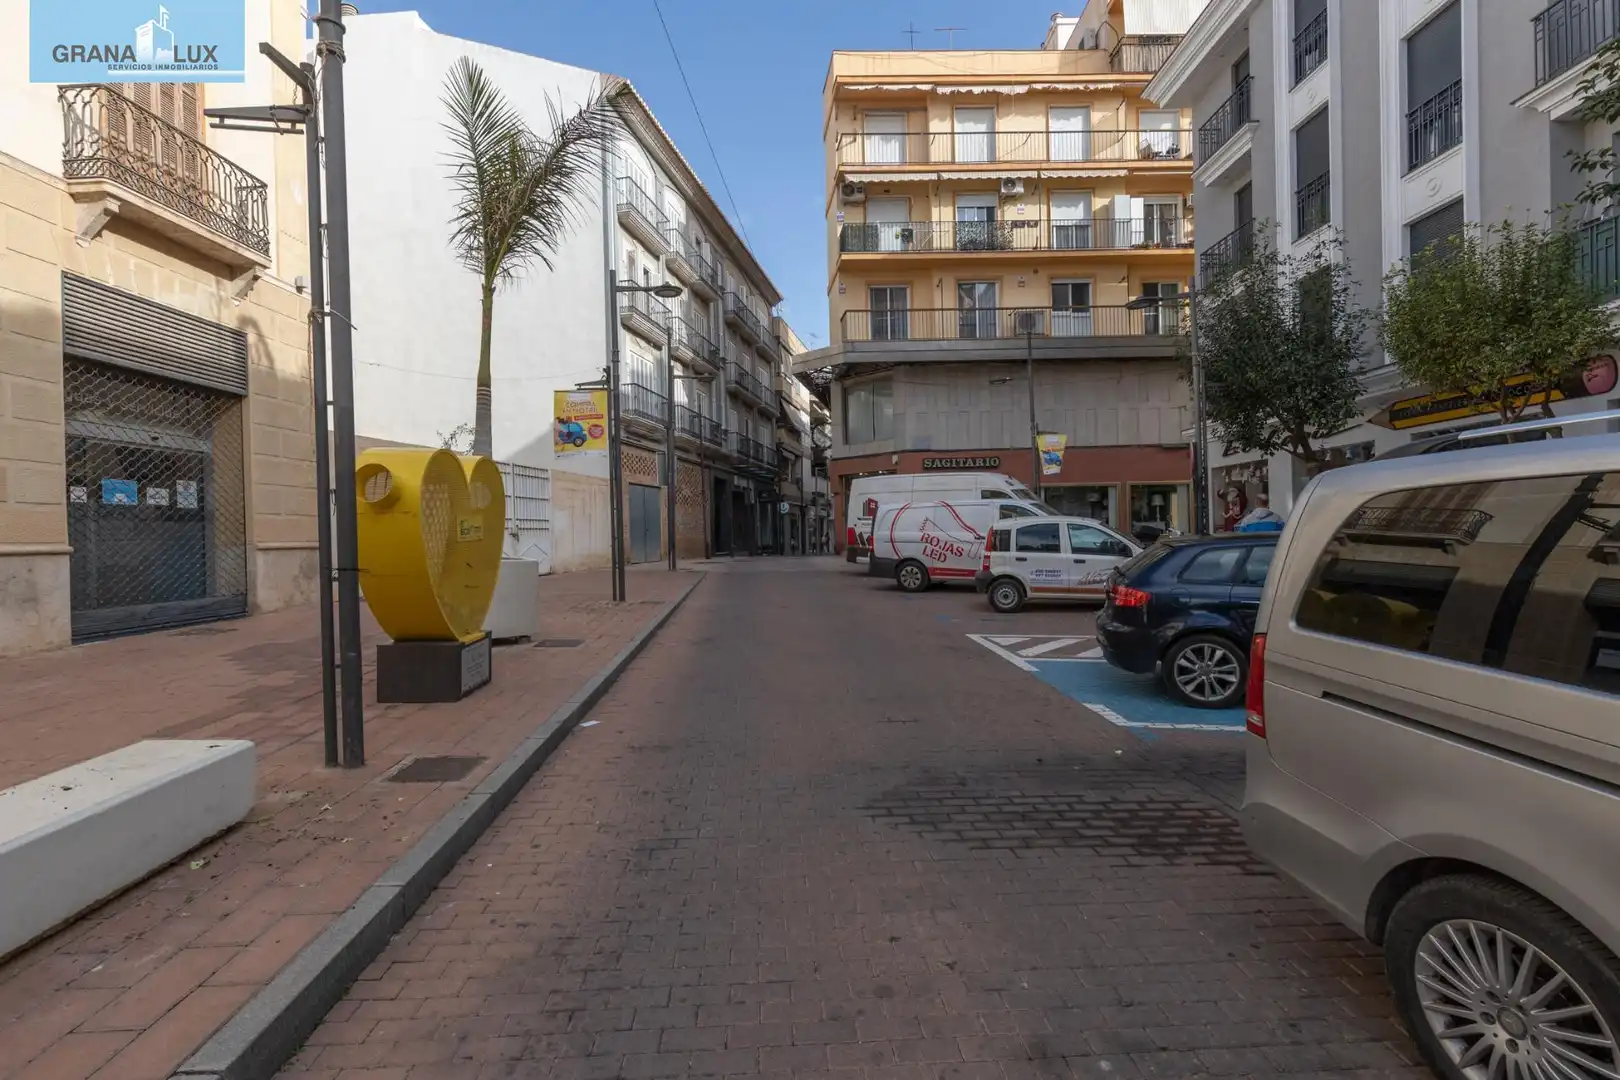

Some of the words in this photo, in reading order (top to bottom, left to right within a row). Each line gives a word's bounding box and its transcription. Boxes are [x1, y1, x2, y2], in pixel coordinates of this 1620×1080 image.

[923, 457, 1000, 468] SAGITARIO
[920, 532, 964, 558] ROJAS
[922, 545, 947, 563] LED
